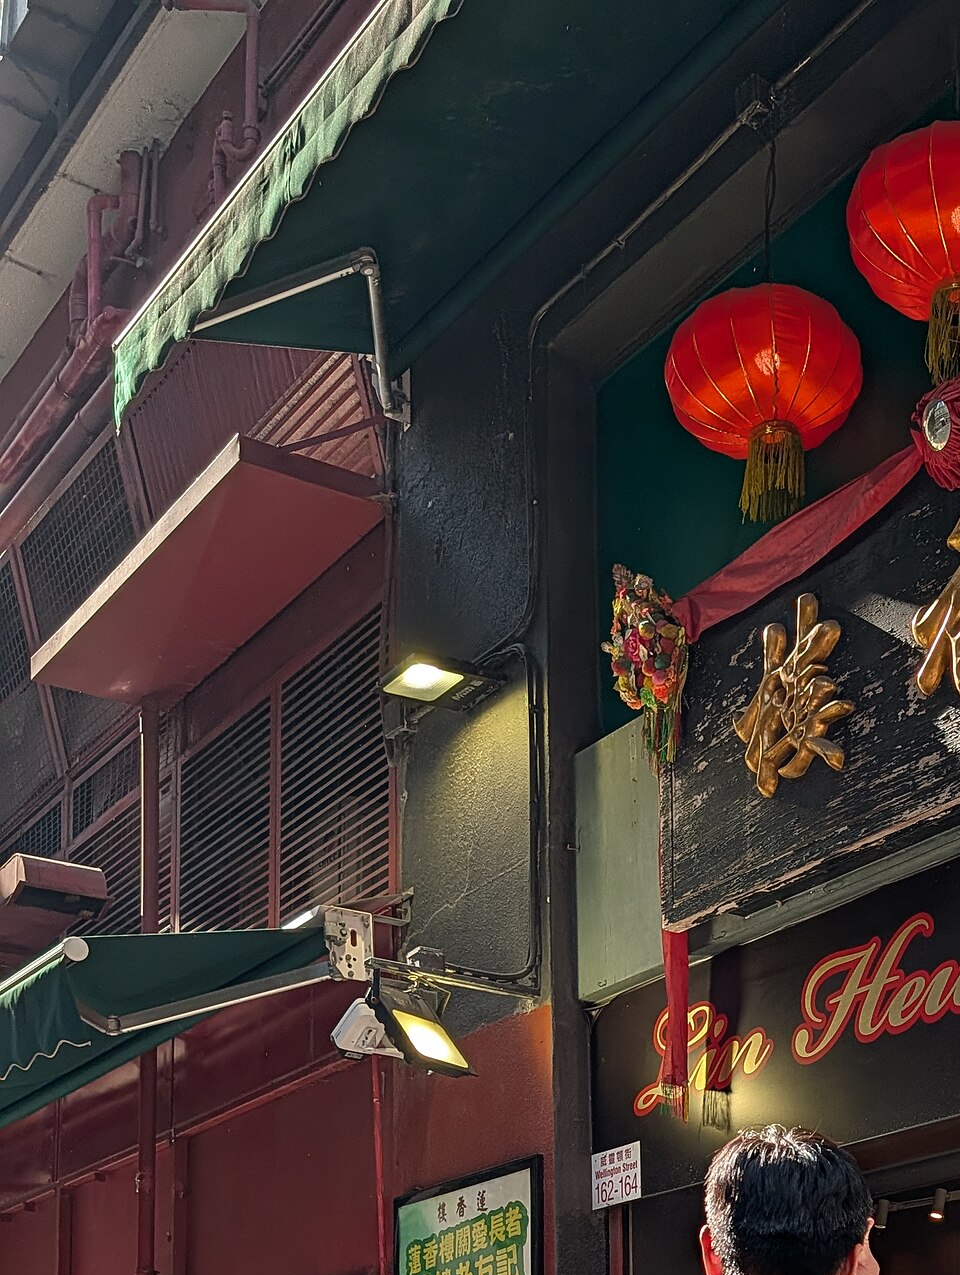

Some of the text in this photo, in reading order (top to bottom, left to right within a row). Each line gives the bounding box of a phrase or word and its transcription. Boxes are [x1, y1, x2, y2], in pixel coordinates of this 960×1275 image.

[595, 1160, 638, 1180] Wellington Street
[595, 1172, 638, 1204] 162-164
[408, 1206, 522, 1275] 蓮香樓關愛長者
